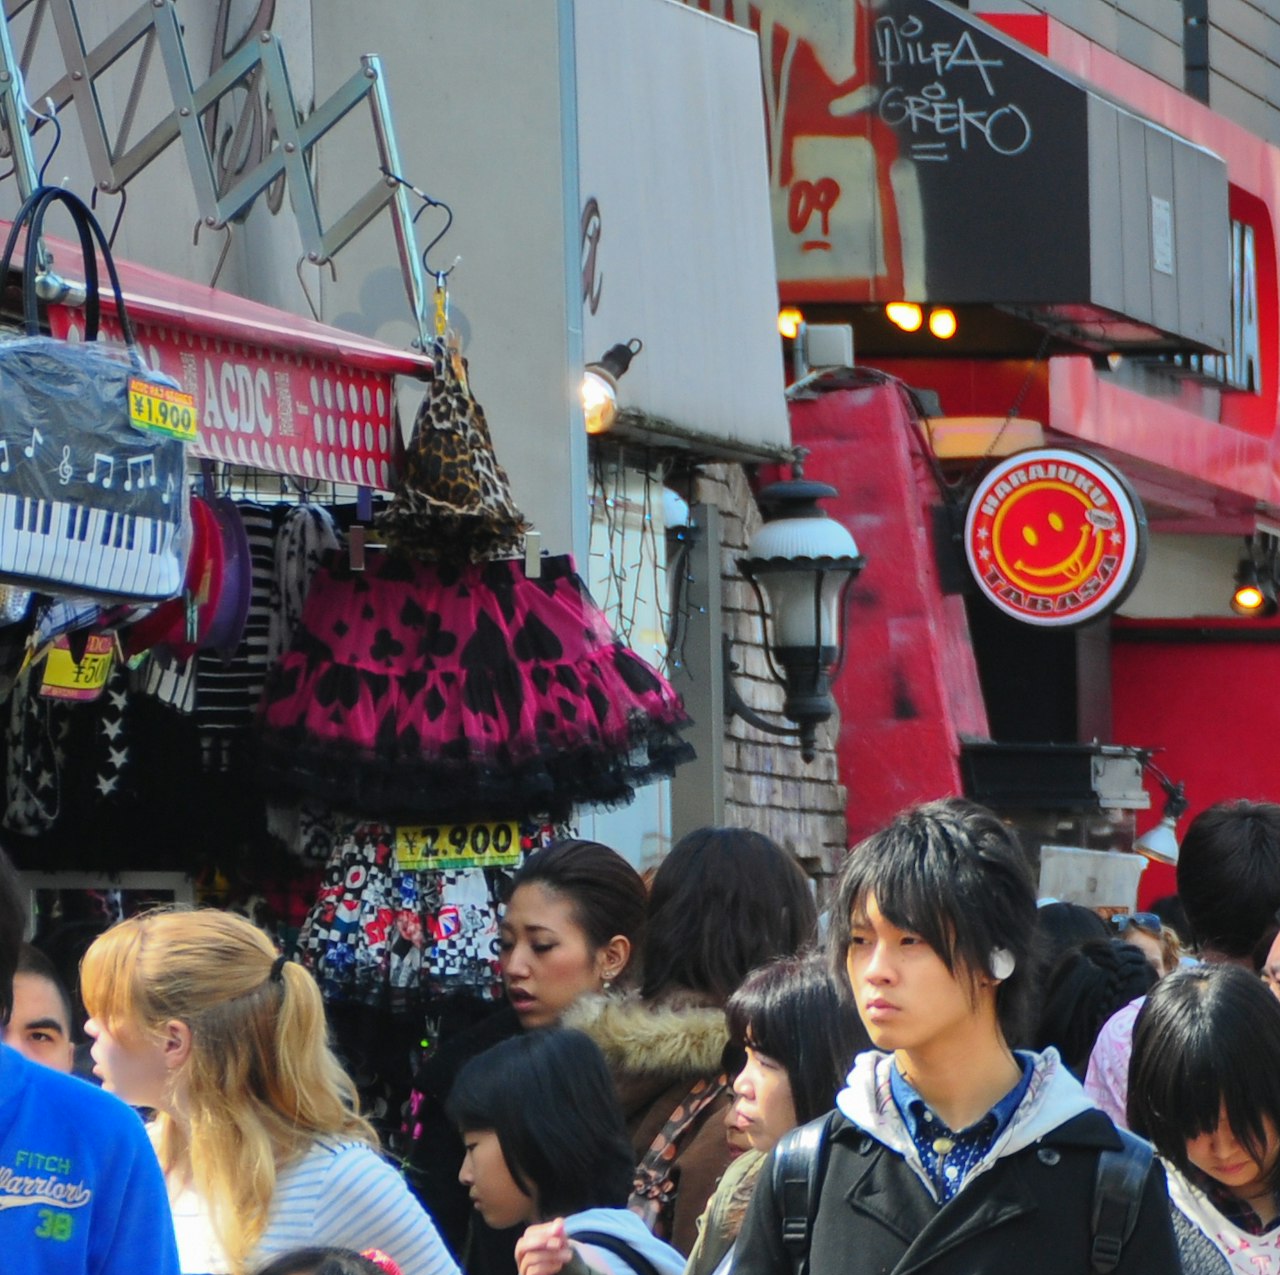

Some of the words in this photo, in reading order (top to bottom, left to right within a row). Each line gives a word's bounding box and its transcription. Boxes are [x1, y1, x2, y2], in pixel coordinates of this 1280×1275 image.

[203, 358, 273, 438] ACDC
[981, 464, 1109, 516] HARAJUKU
[984, 555, 1119, 612] TABASA
[16, 1150, 72, 1175] FITCH
[35, 1209, 73, 1242] 38
